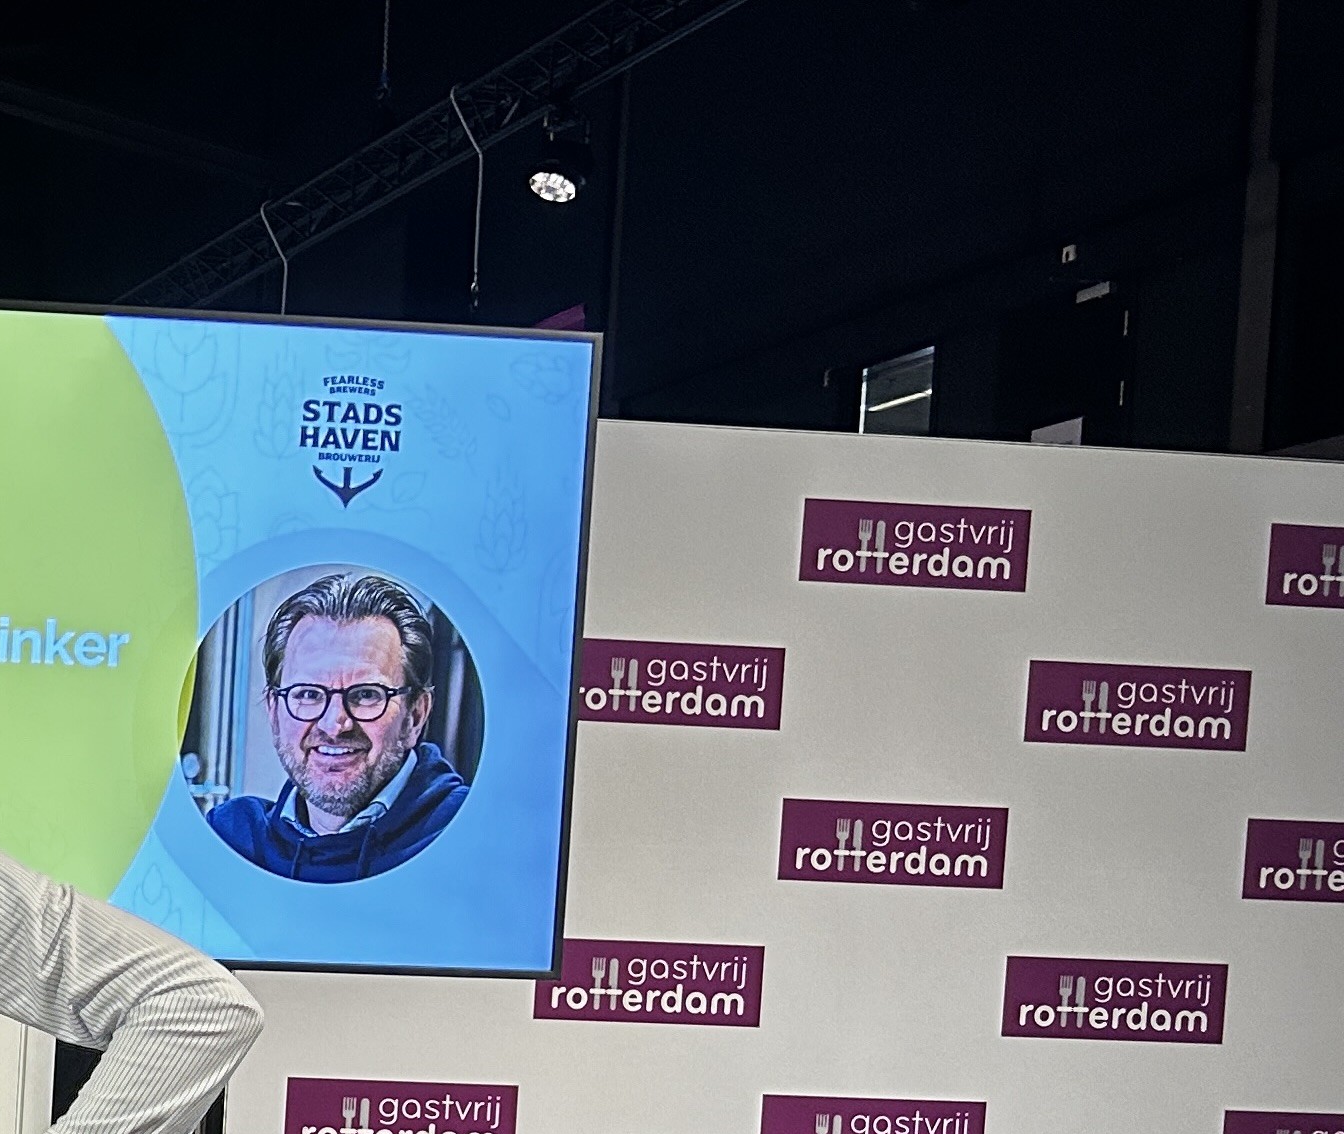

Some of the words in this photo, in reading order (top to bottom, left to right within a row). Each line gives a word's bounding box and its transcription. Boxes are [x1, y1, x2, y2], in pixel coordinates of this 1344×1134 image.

[323, 375, 385, 390] FEARLESS
[329, 386, 377, 397] BREWERS
[302, 398, 403, 427] STADS
[299, 425, 402, 452] HAVEN
[318, 452, 381, 463] BROUWERIJ
[892, 516, 1014, 552] gastvrij
[816, 536, 1012, 580] rotterdam
[647, 655, 768, 692] gastvrij
[578, 681, 766, 719] otterdam
[1115, 677, 1234, 712] gastvrij
[1040, 697, 1232, 740] rotterdam
[871, 814, 992, 849] gastvrij
[794, 836, 990, 878] rotterdam
[1259, 861, 1344, 892] rotte
[627, 952, 748, 987] gastvrij
[550, 974, 746, 1016] rotterdam
[1093, 971, 1213, 1005] gastvrij
[1018, 992, 1210, 1033] rotterdam
[378, 1092, 501, 1127] gastvrij
